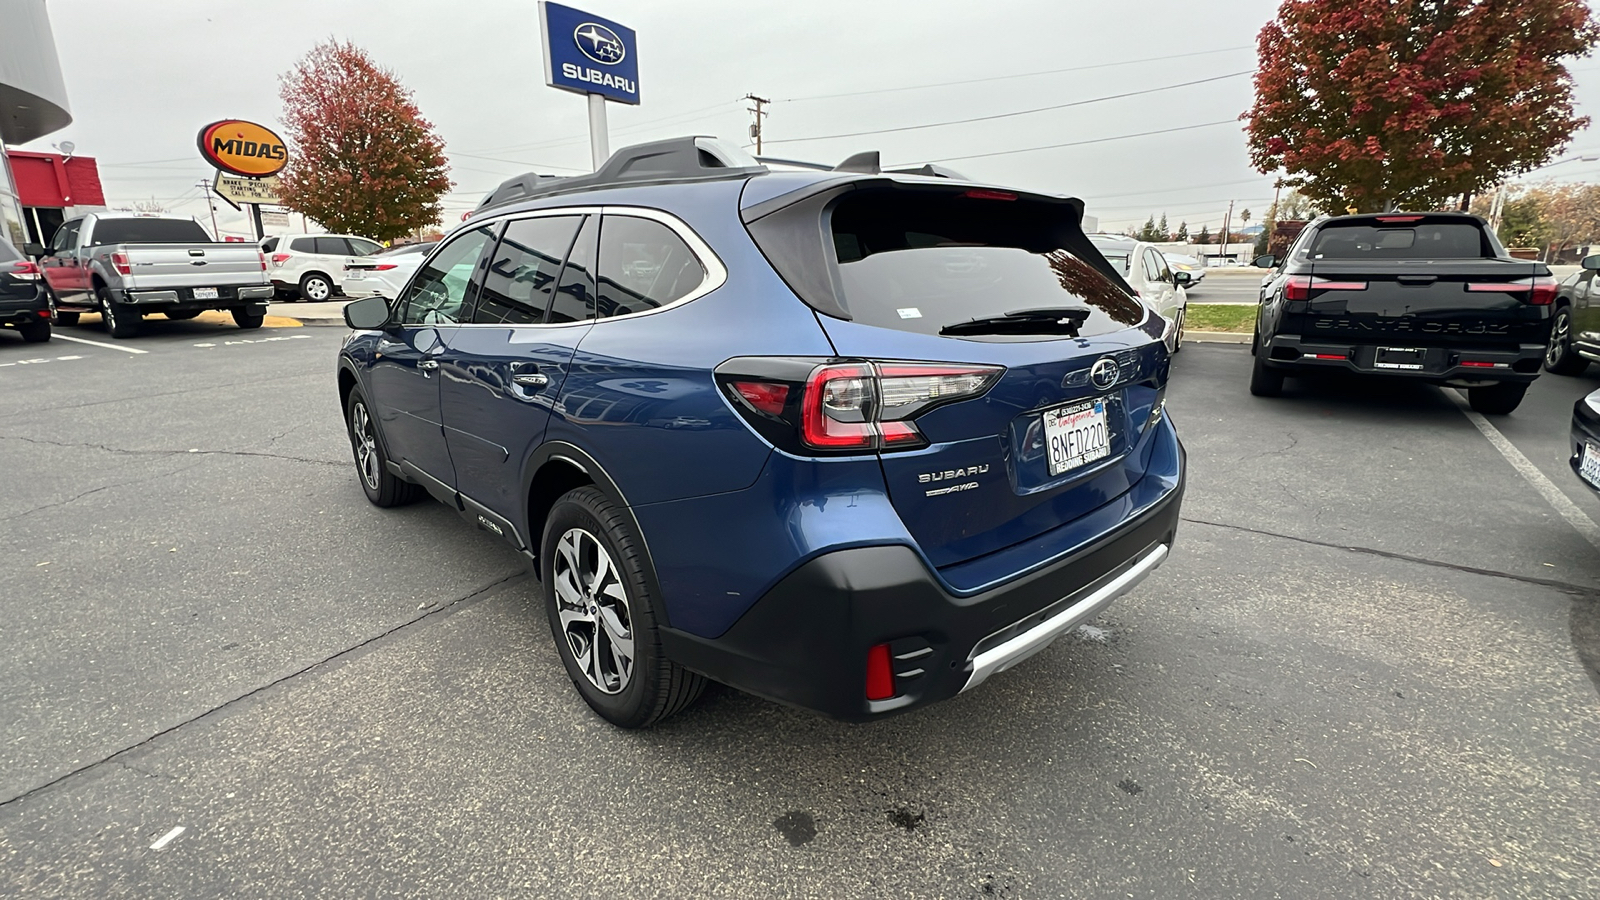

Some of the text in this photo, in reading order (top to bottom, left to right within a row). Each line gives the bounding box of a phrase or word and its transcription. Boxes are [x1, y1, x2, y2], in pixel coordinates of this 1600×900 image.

[562, 62, 636, 94] SUBARU
[213, 137, 285, 160] MIDAS
[1315, 318, 1414, 332] SANTA
[1048, 411, 1095, 428] DEC California
[1051, 422, 1105, 462] 8NFD220
[1056, 446, 1107, 474] REDDING SUBARU
[917, 464, 990, 484] SUBARU
[946, 482, 980, 495] AWD
